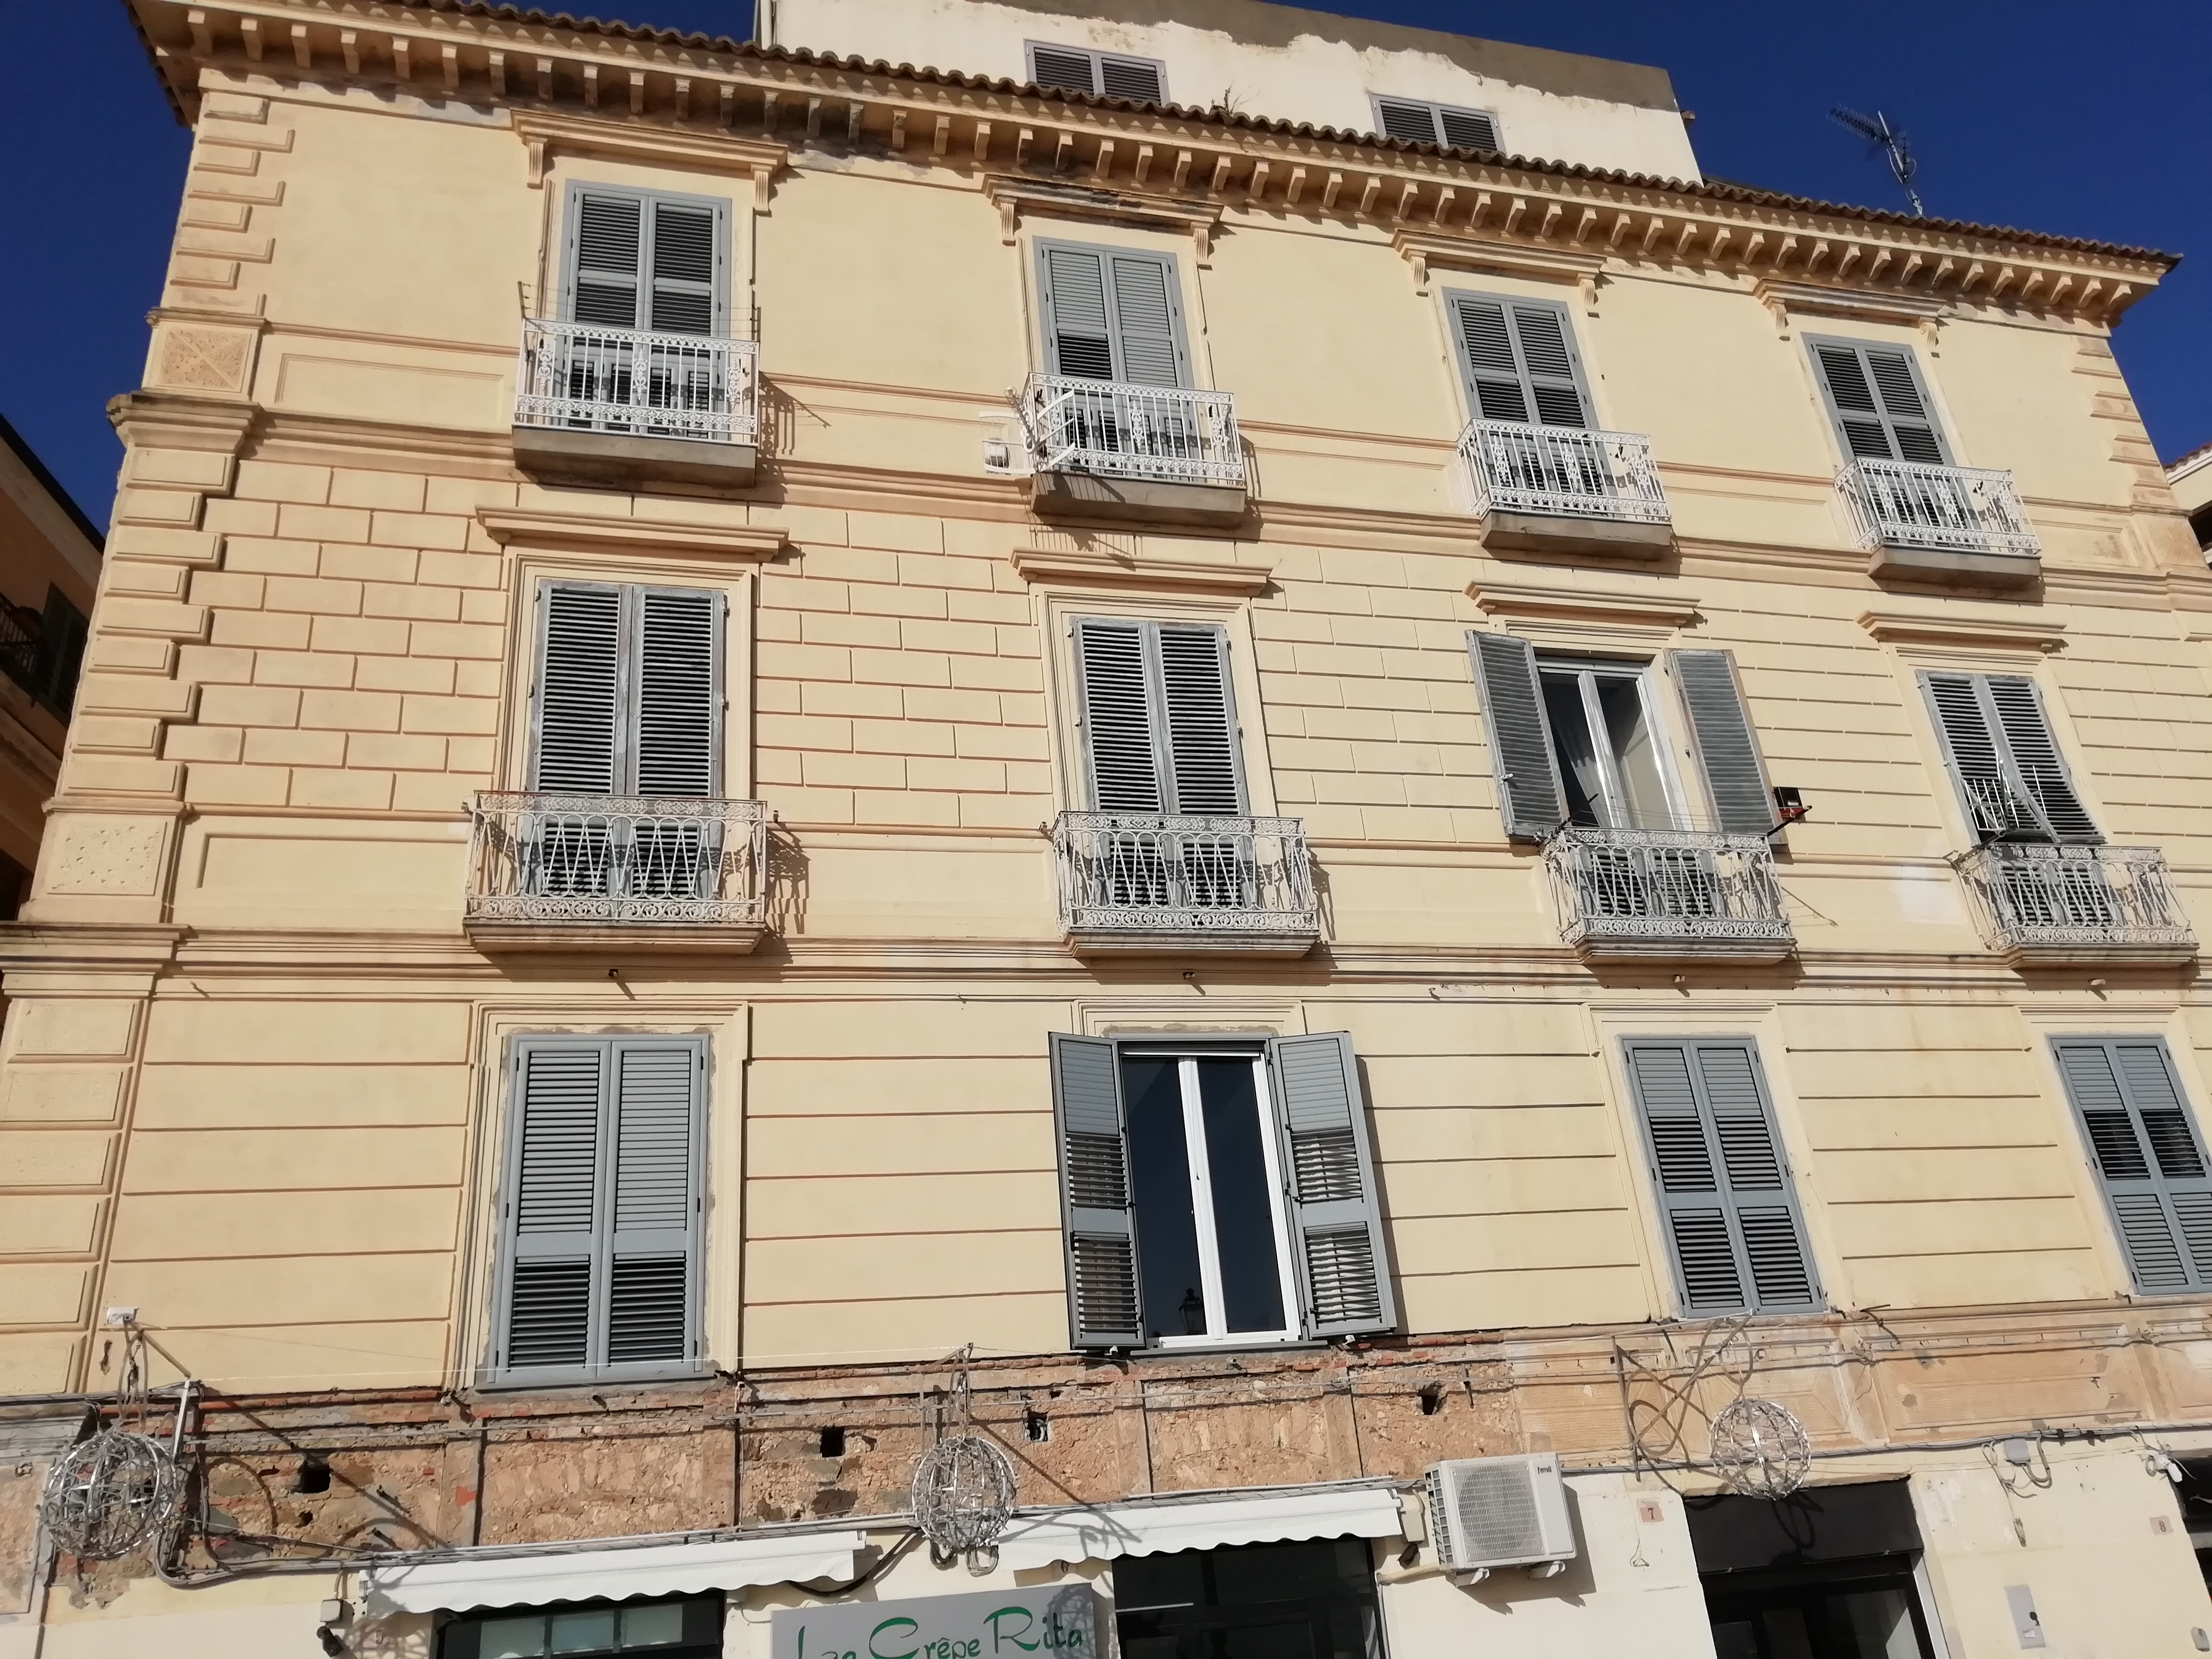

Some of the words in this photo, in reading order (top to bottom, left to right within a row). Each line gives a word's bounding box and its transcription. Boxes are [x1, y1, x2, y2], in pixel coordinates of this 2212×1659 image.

[1647, 1507, 1656, 1520] 7
[2159, 1520, 2166, 1532] 8
[375, 1630, 383, 1645] 5
[869, 1617, 981, 1659] Crêpe
[983, 1606, 1082, 1654] Rita
